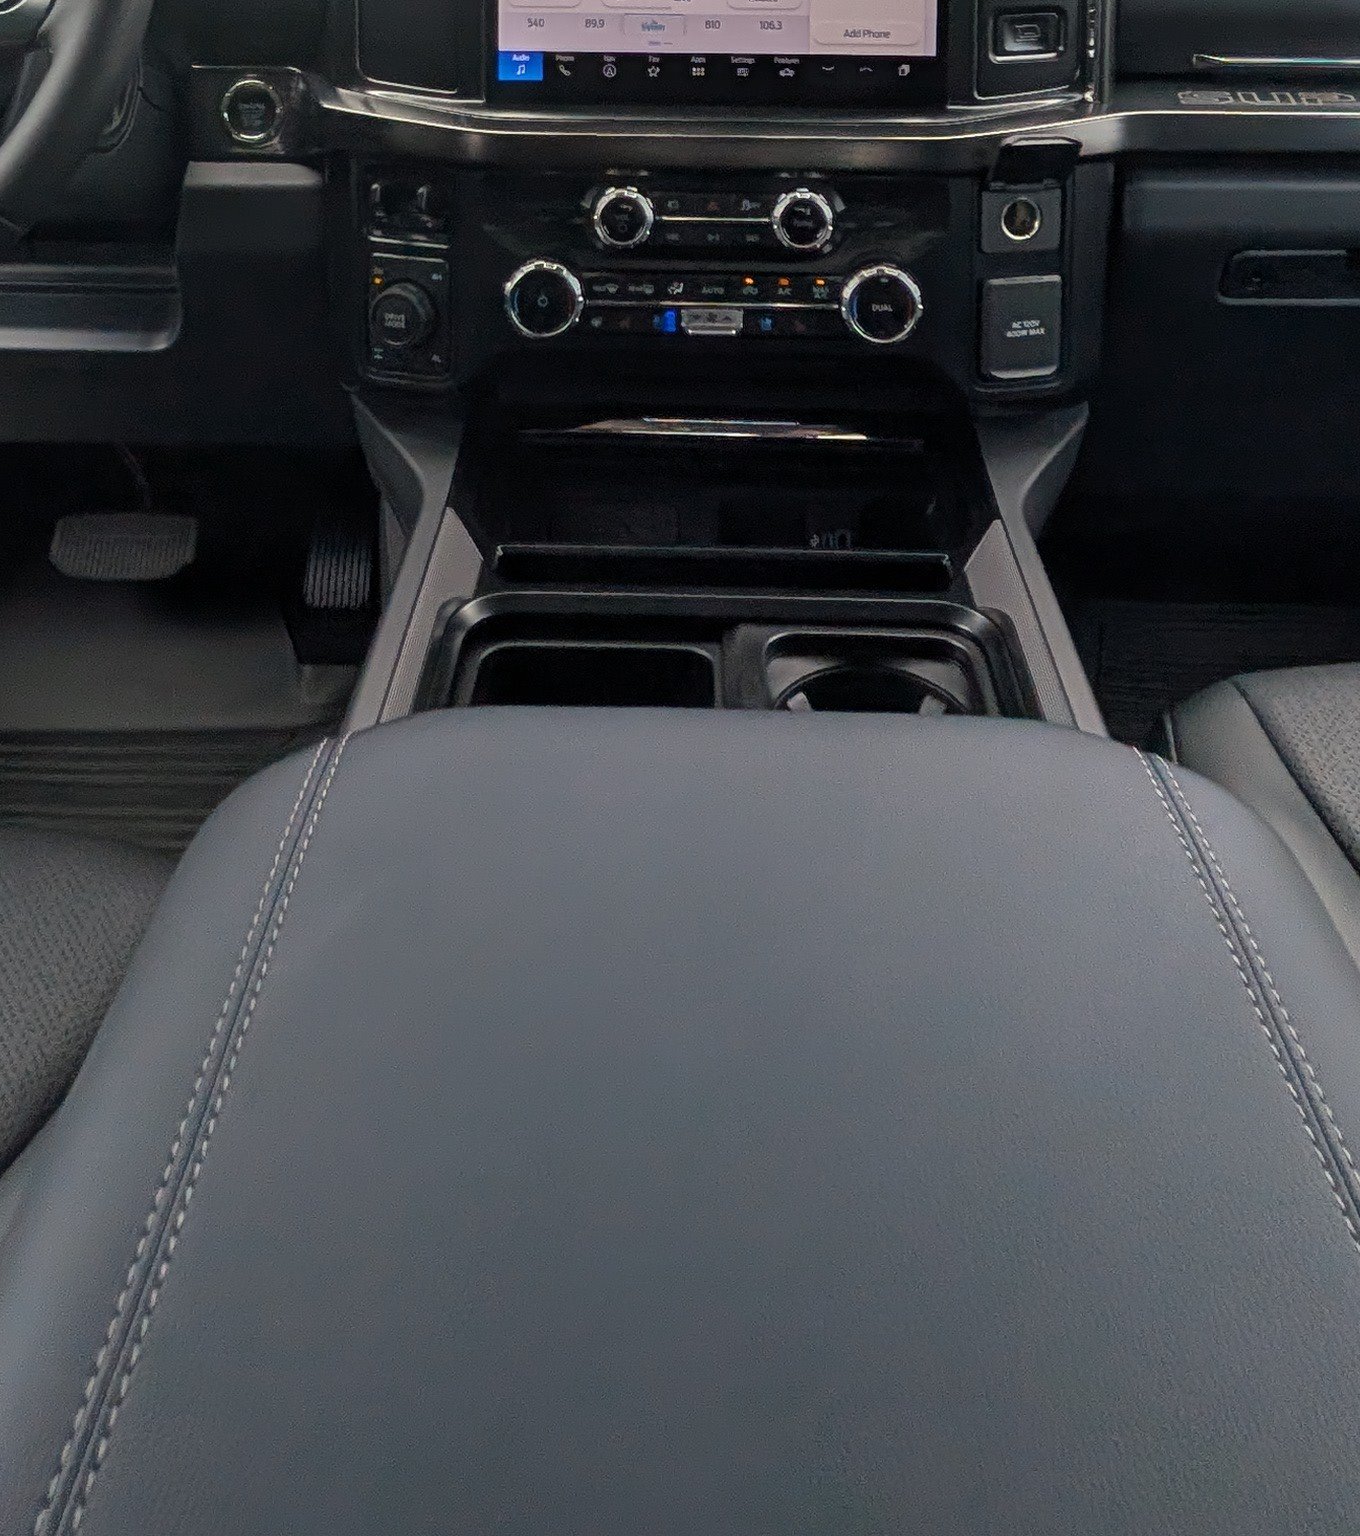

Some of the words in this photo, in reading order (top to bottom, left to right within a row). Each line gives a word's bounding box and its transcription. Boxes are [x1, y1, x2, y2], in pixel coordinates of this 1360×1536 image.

[527, 18, 545, 28] 540
[704, 20, 721, 30] 810
[843, 28, 862, 39] Add
[862, 28, 891, 39] Phone
[871, 303, 893, 313] DUAL
